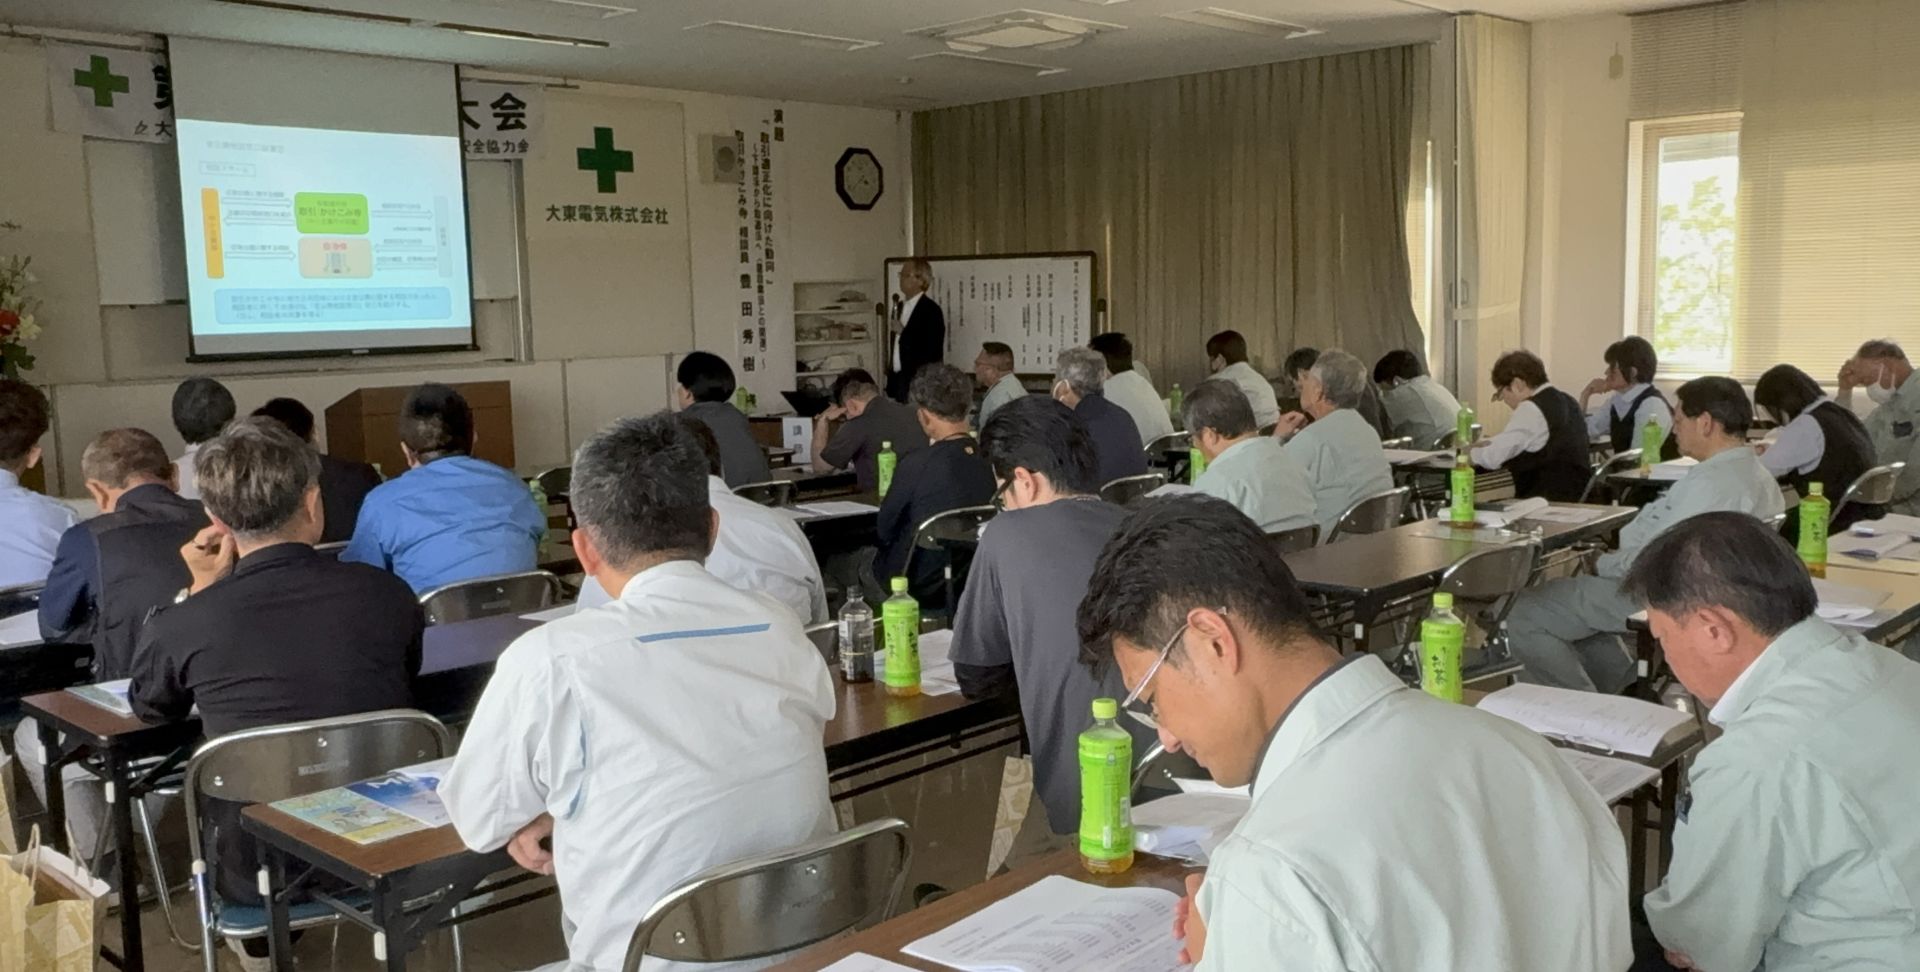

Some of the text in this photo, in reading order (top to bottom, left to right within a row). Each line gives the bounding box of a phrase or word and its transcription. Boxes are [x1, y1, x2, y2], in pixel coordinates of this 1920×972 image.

[774, 108, 784, 142] 演題
[546, 204, 669, 225] 大東電気株式会社
[739, 226, 750, 264] 相談員
